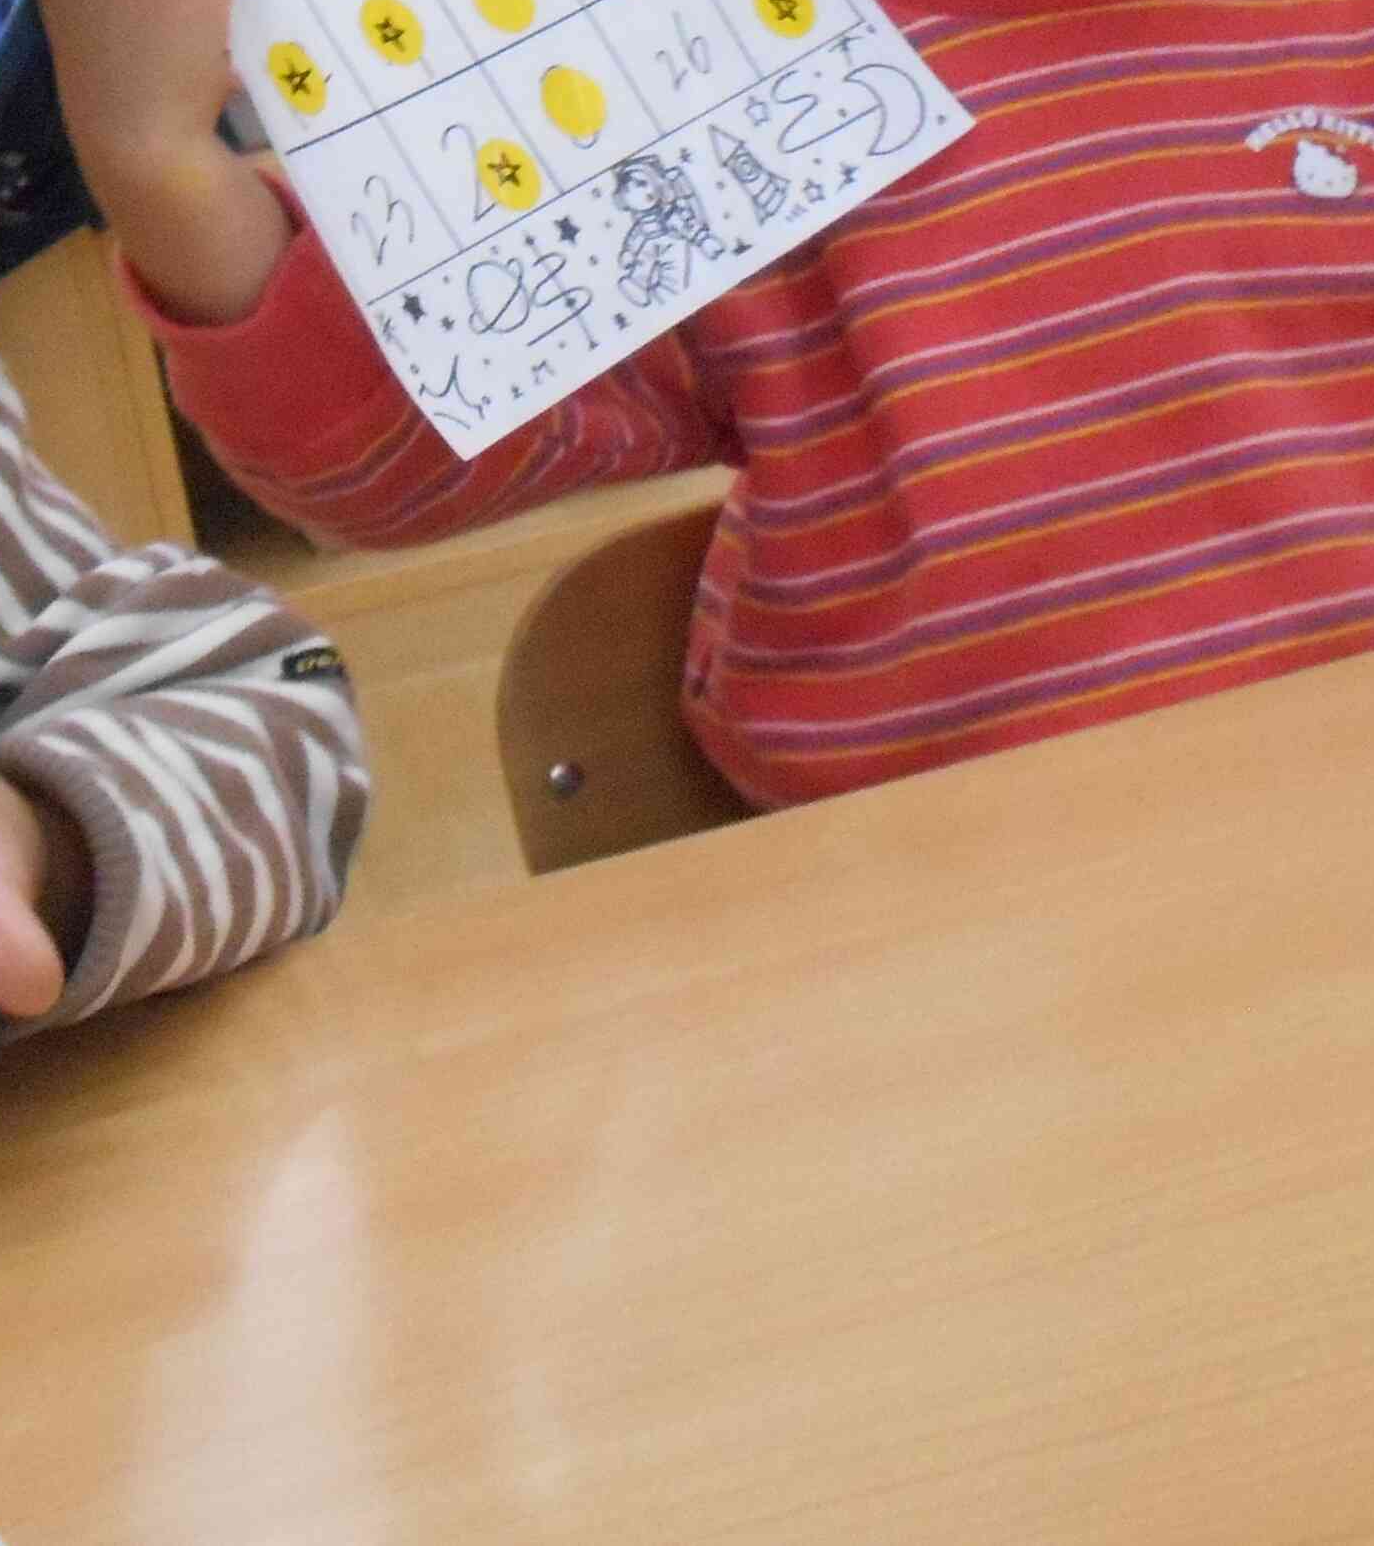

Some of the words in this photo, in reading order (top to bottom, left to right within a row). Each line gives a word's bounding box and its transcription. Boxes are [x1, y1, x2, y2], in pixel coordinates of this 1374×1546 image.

[351, 174, 416, 267] 23
[655, 9, 712, 92] 26
[1243, 105, 1318, 152] HELLO
